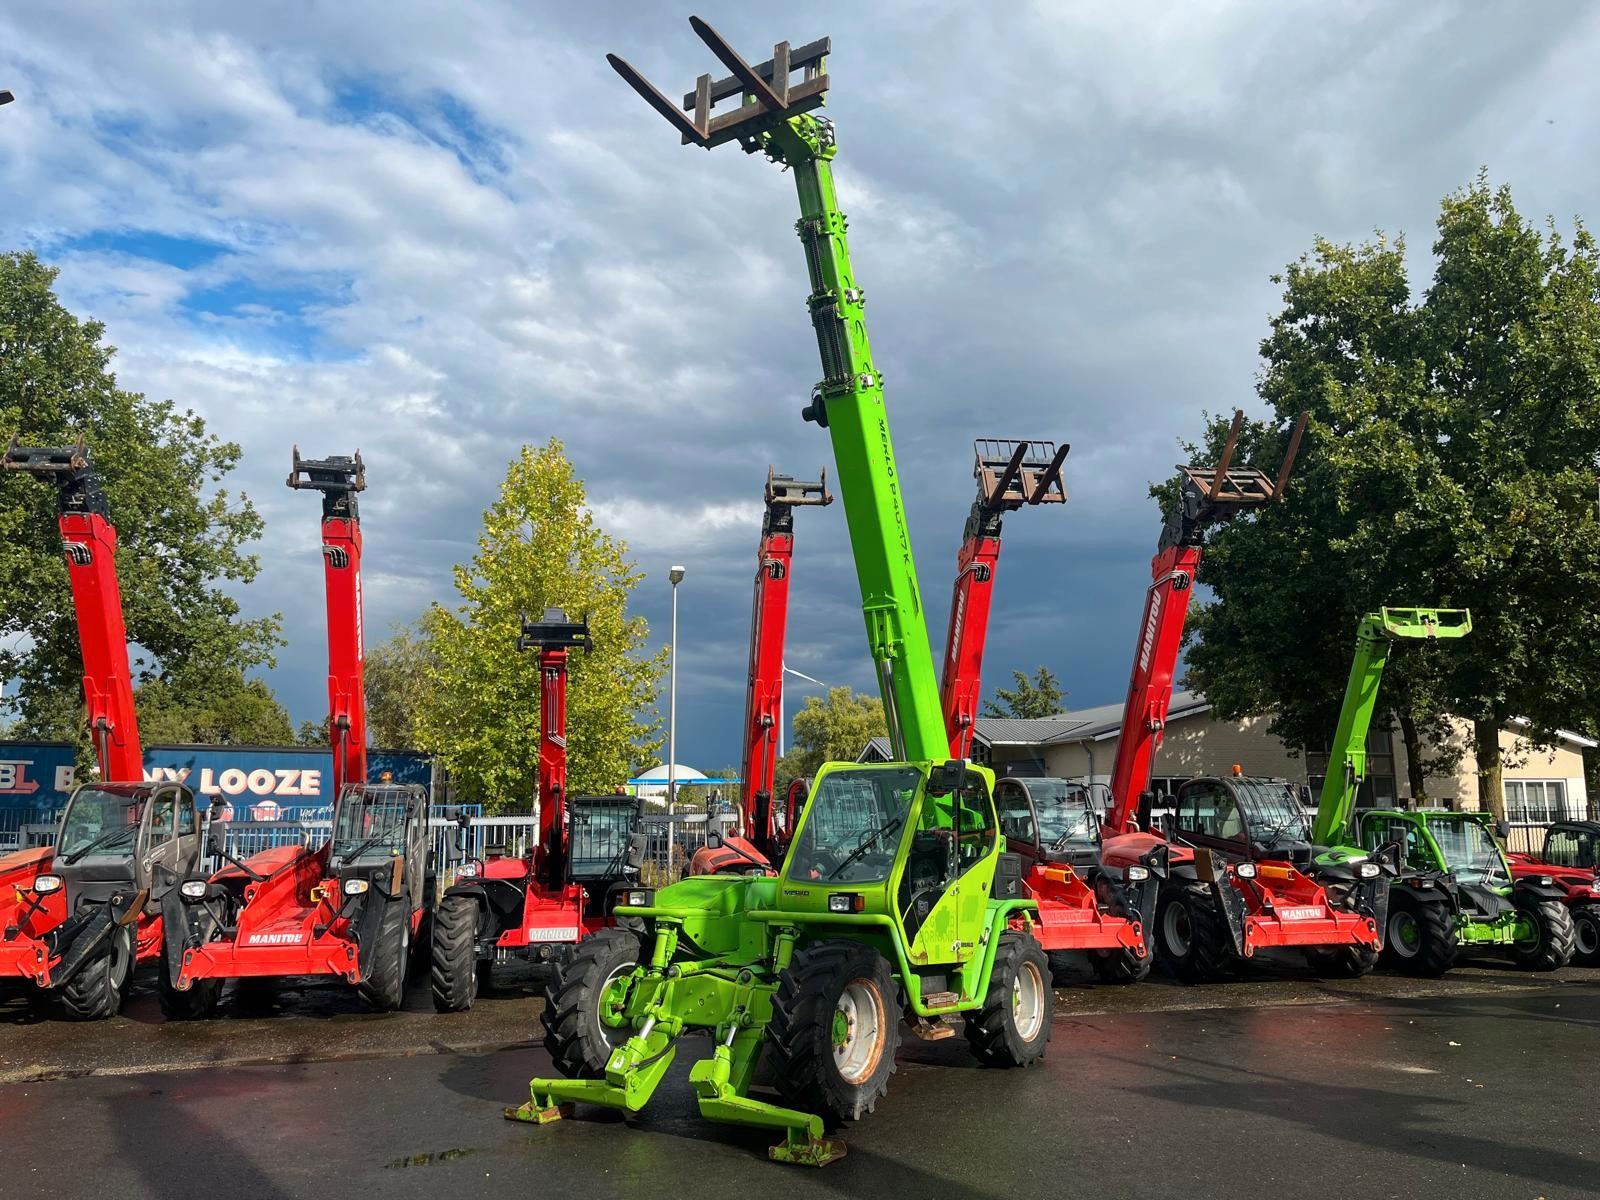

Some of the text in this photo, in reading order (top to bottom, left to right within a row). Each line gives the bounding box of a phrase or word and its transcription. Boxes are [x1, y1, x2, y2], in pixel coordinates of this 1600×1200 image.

[878, 418, 894, 478] MERLO
[951, 589, 966, 664] MANITOU
[1139, 589, 1161, 673] MANITOU
[200, 768, 321, 796] LOOZE
[1281, 908, 1321, 920] MANITOU
[249, 933, 304, 944] MANITOU
[531, 928, 576, 940] MANITOU
